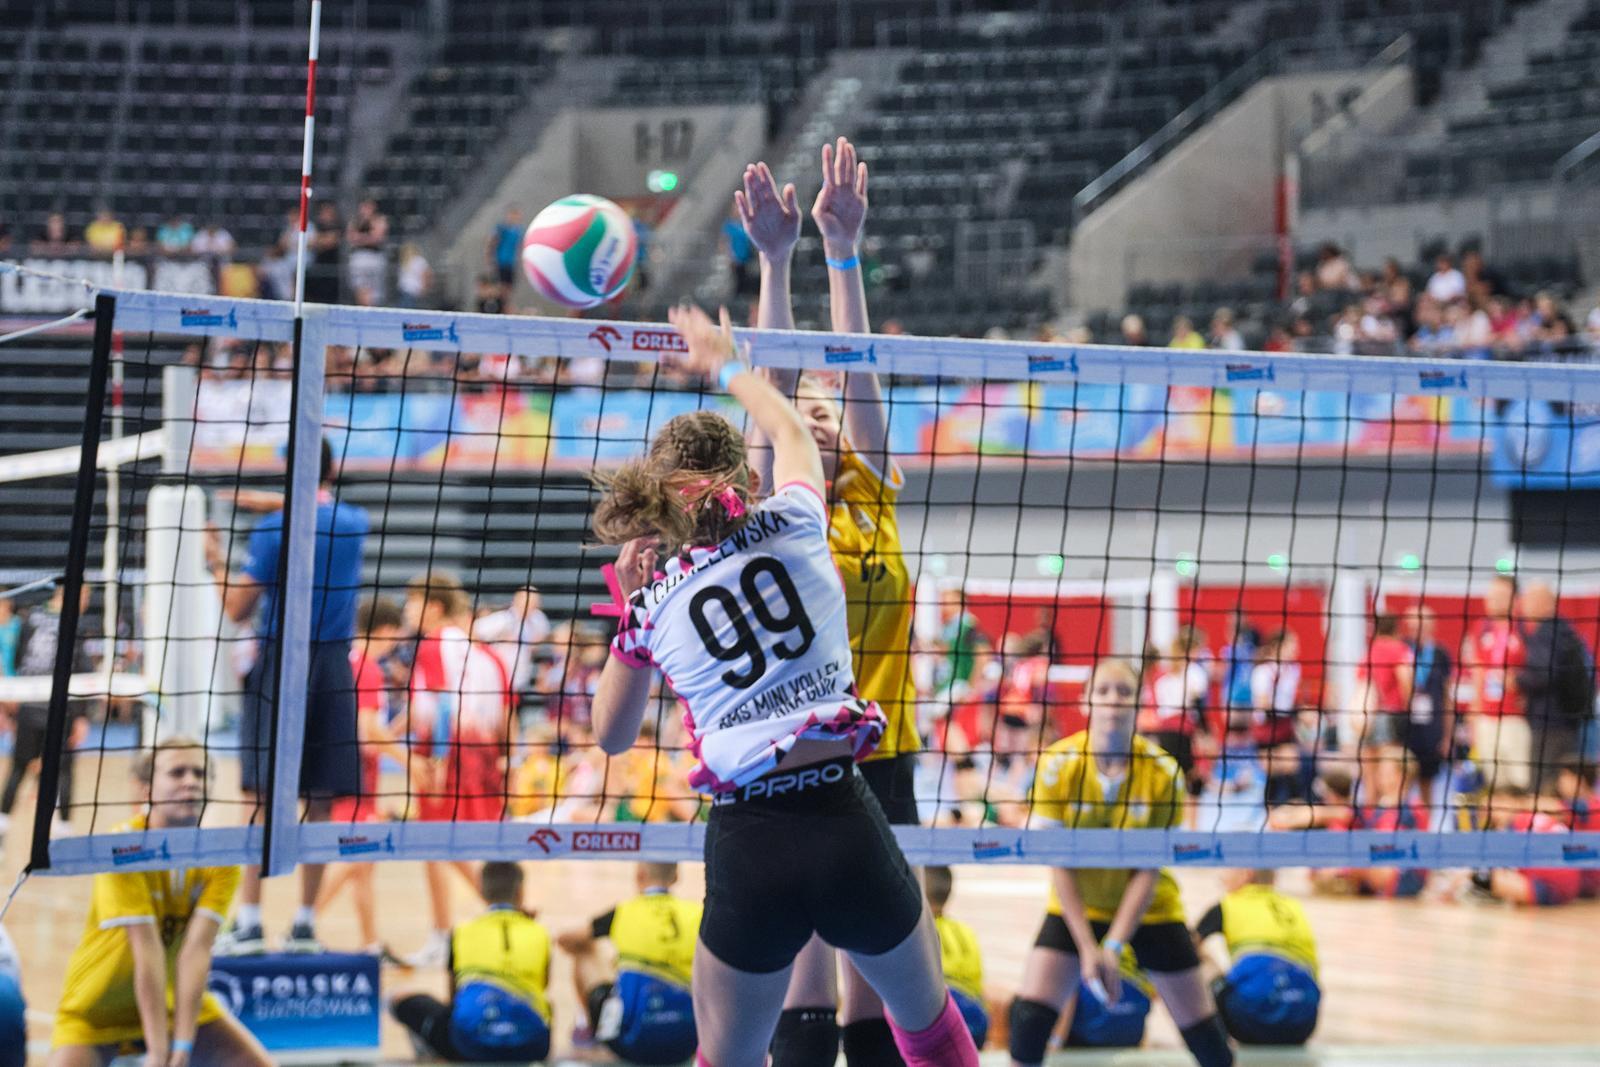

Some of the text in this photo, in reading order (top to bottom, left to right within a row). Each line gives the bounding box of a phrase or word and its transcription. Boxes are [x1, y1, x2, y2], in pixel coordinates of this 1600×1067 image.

[689, 556, 815, 689] 99
[753, 684, 788, 714] MINI
[575, 833, 637, 849] ORLEN
[252, 972, 373, 999] POLSKA
